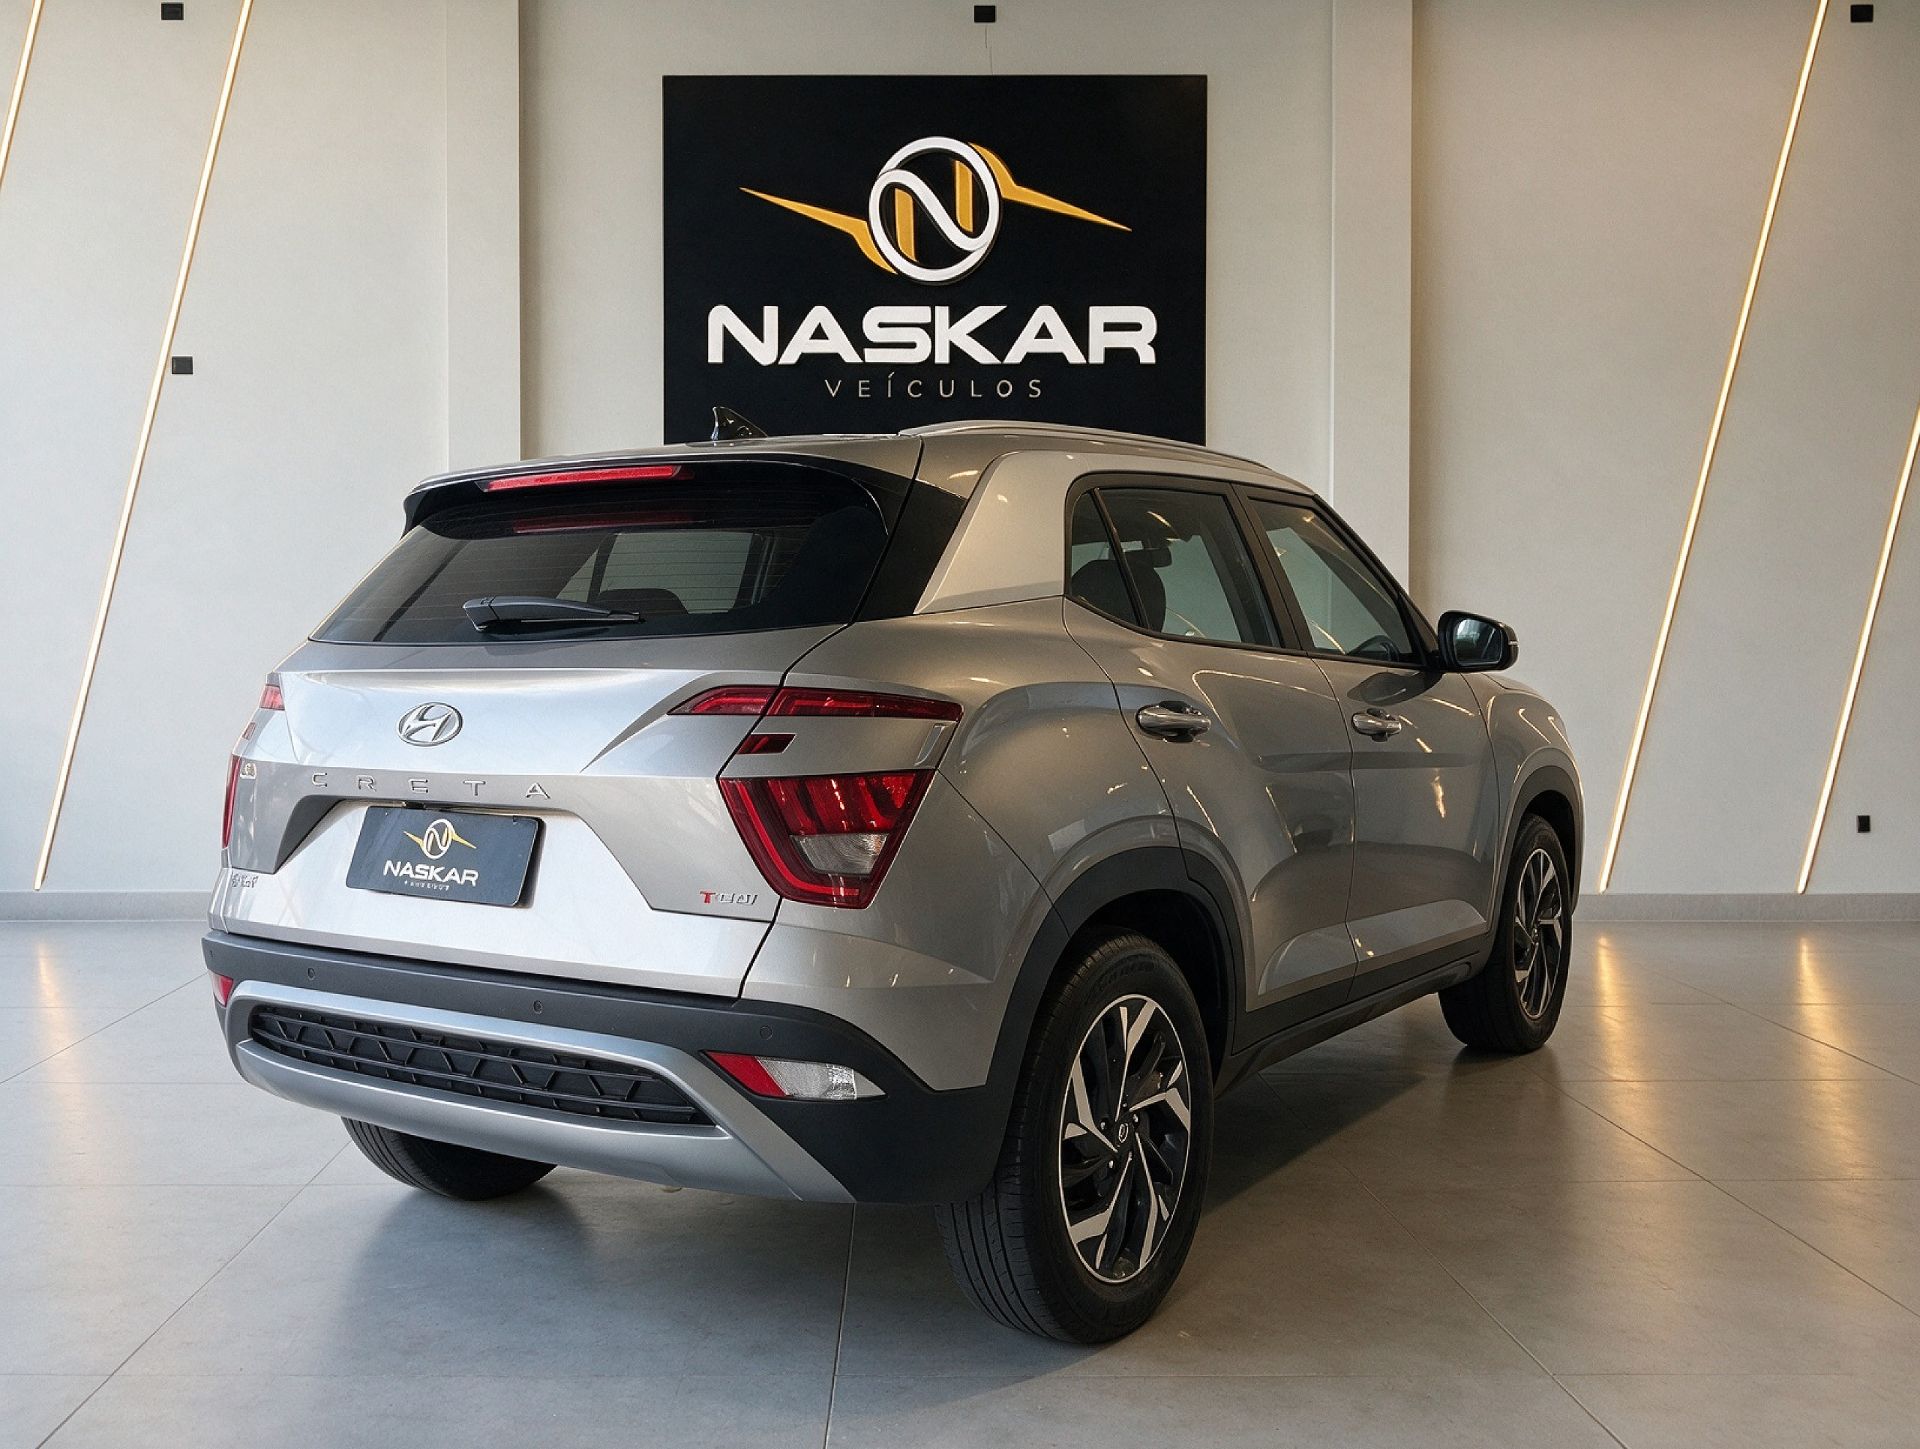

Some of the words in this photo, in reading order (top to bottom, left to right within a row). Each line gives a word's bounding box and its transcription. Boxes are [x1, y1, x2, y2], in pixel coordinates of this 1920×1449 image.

[708, 304, 1157, 366] NASKAR
[825, 371, 1041, 398] VEÍCULOS
[311, 772, 551, 800] CRETA
[383, 860, 479, 887] NASKAR
